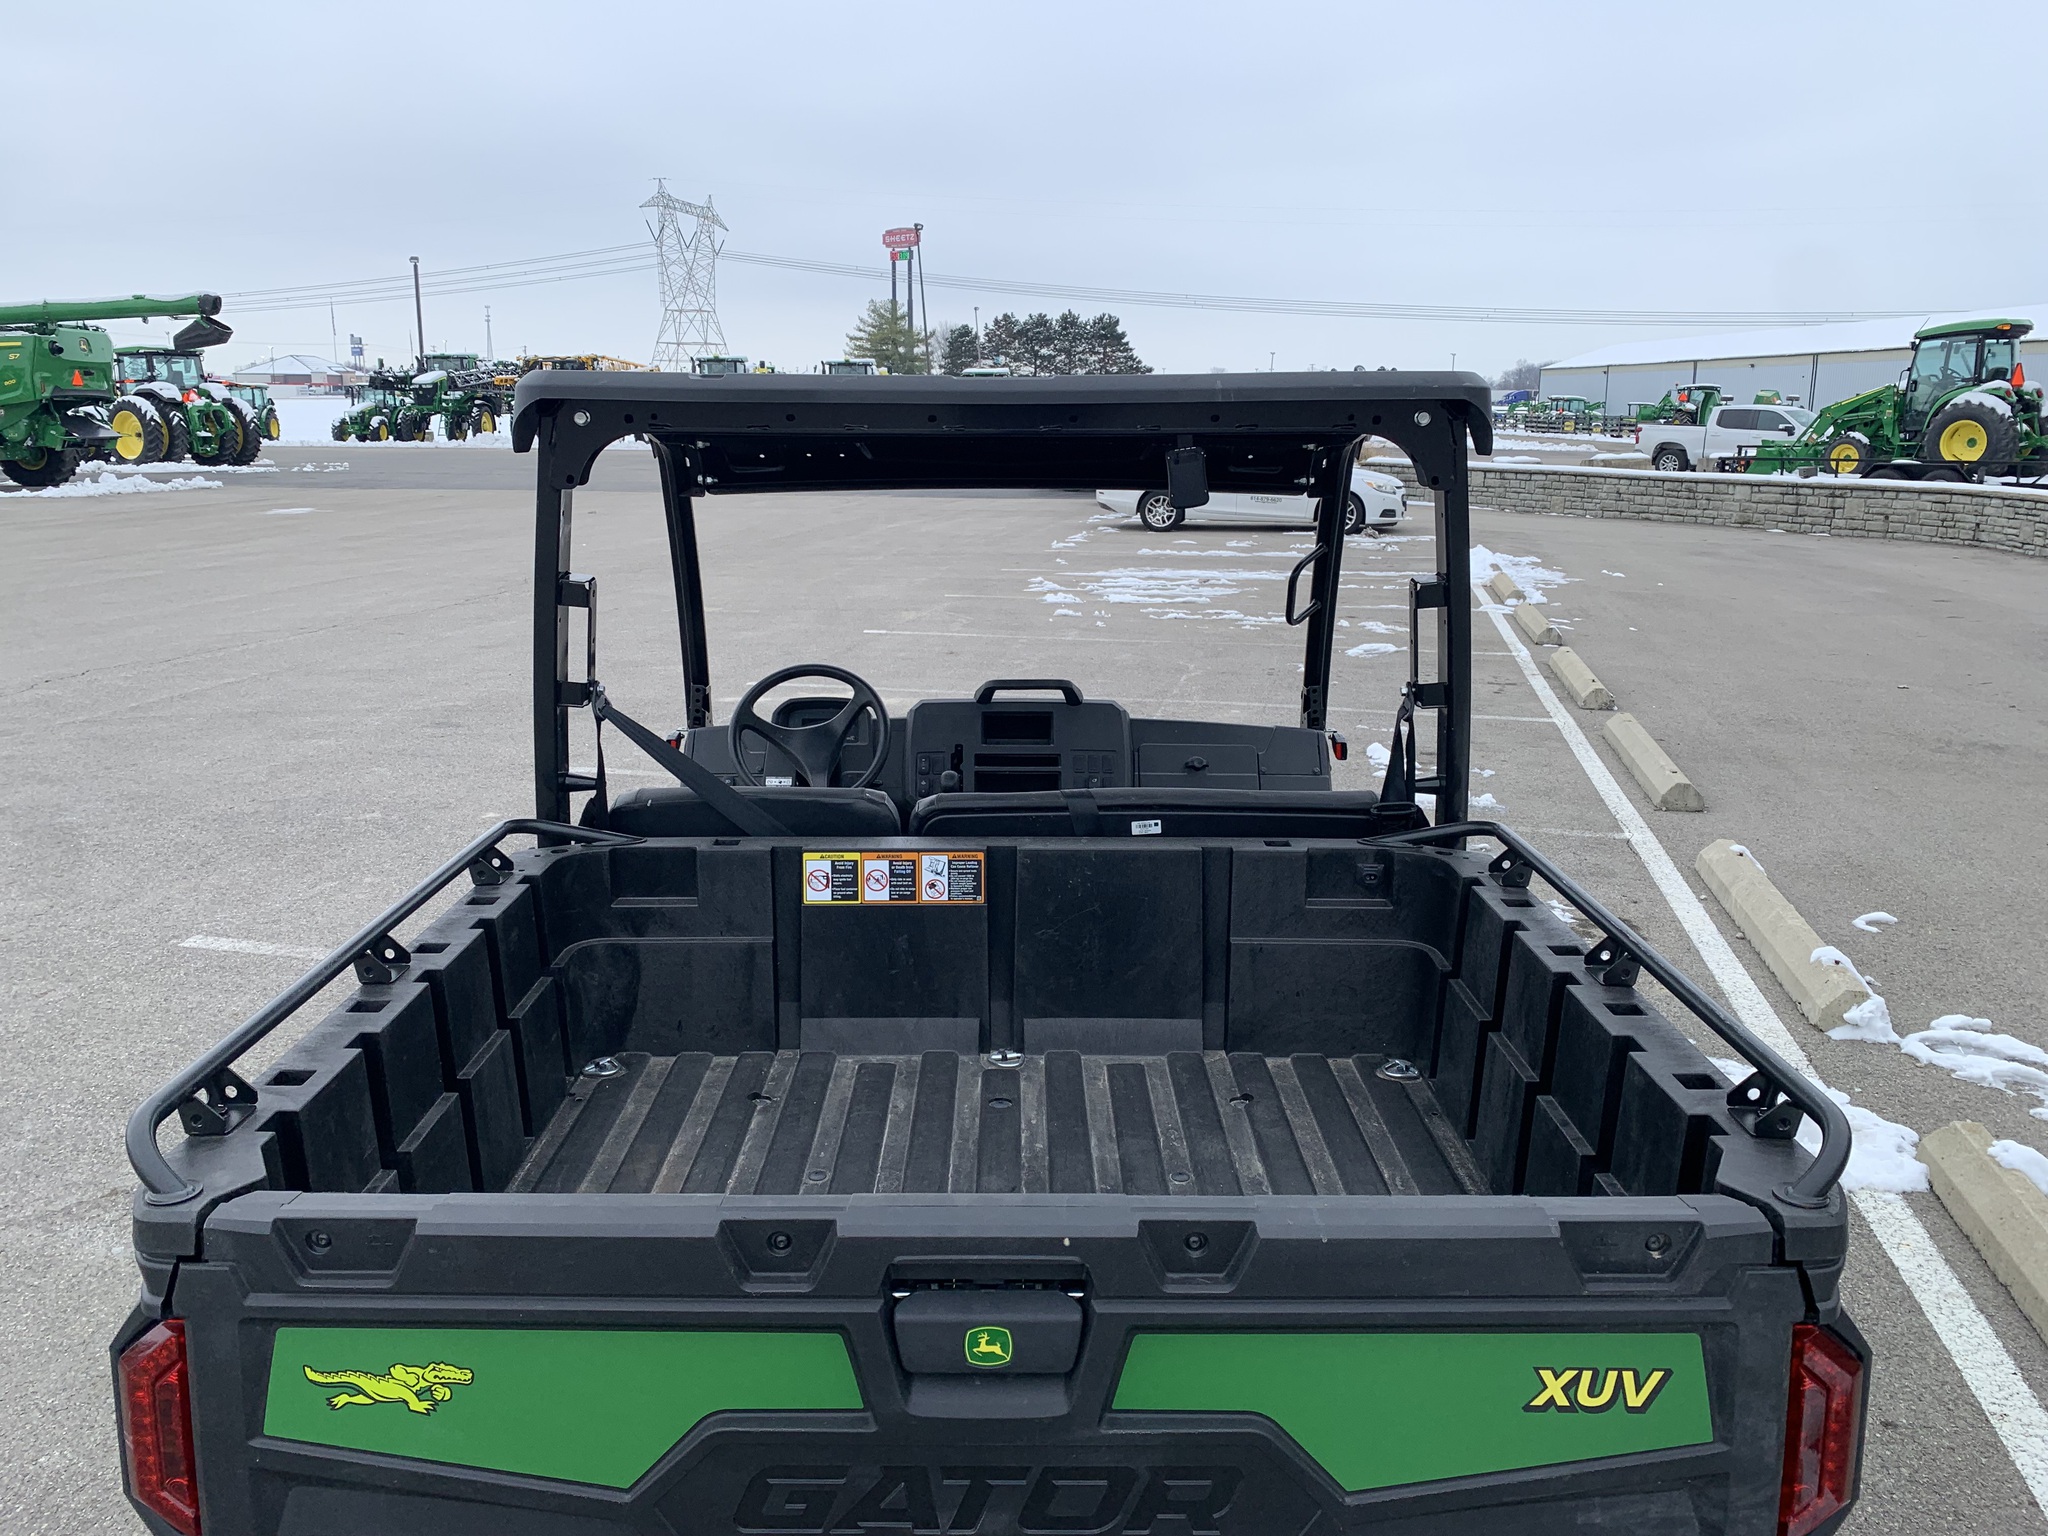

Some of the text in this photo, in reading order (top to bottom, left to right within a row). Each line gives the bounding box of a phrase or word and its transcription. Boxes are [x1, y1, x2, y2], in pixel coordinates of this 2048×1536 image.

[885, 234, 914, 242] SHEETZ
[1521, 1366, 1674, 1414] XUV
[733, 1464, 1246, 1535] GATOR
